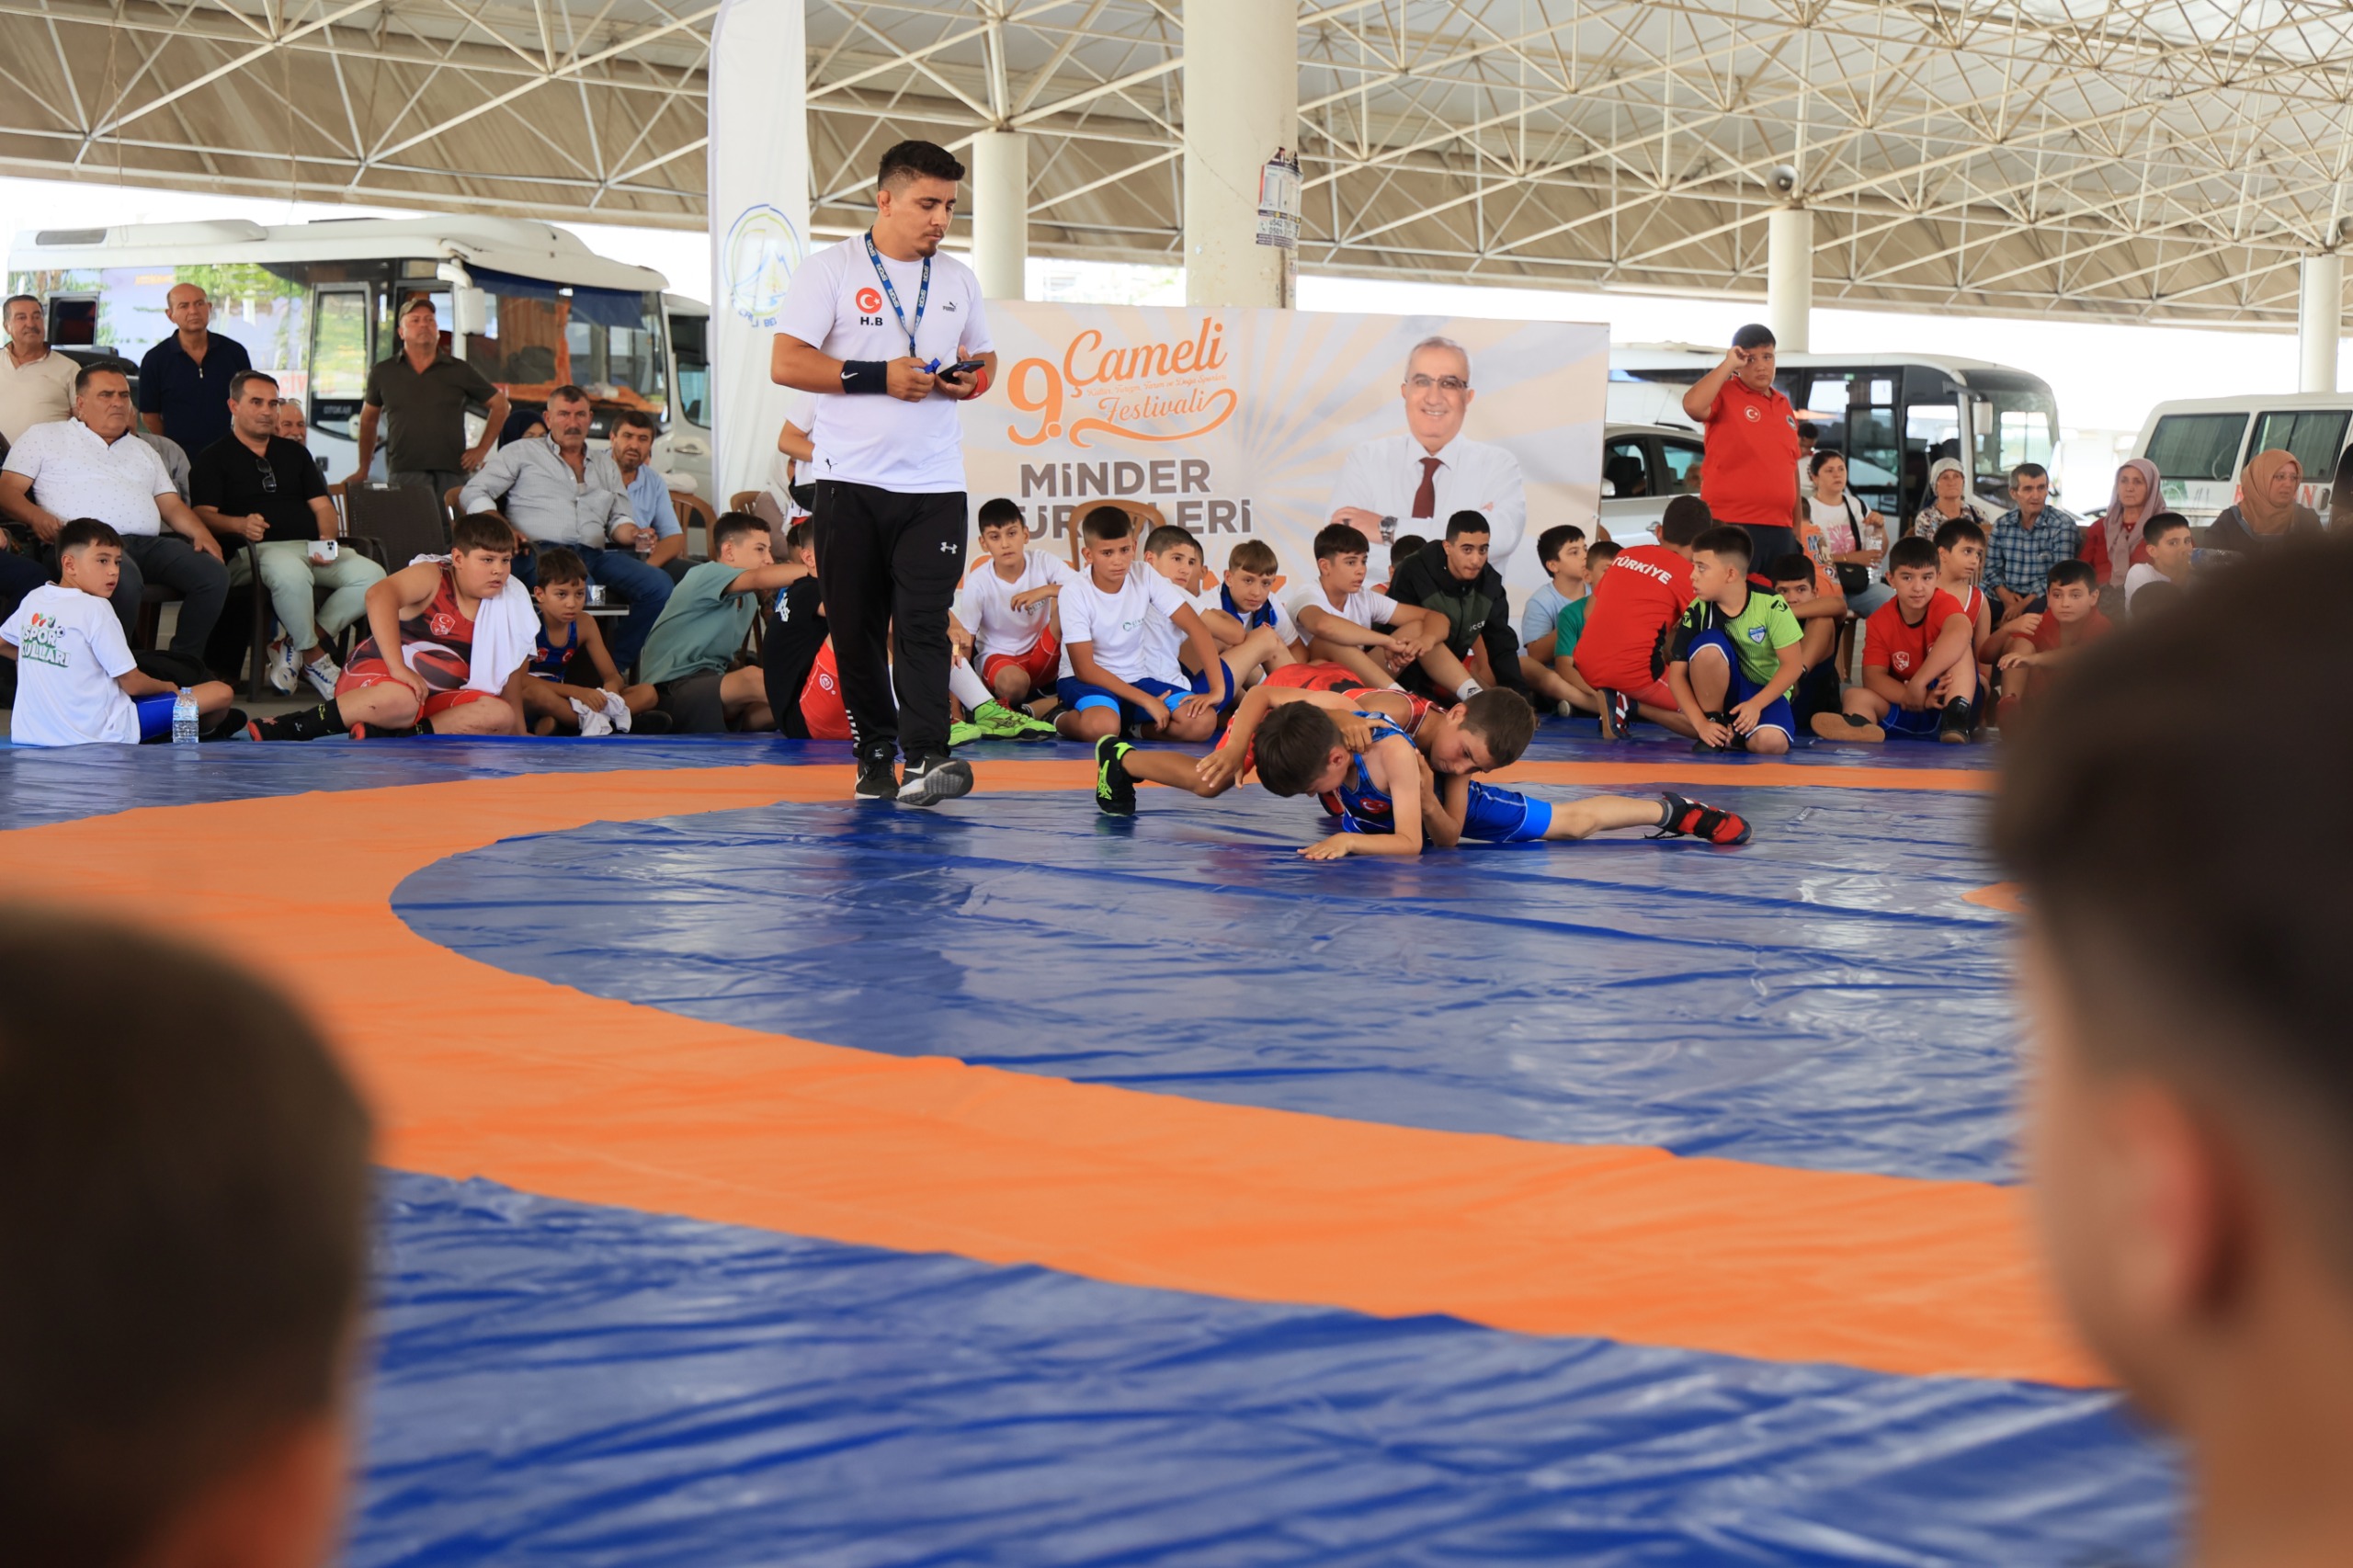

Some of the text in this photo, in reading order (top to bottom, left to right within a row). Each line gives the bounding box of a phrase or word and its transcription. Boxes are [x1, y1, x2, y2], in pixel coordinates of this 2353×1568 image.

[876, 263, 888, 281] SPOR
[888, 288, 900, 308] SPOR
[918, 289, 926, 308] SPOR
[860, 316, 883, 326] H.B
[1007, 317, 1228, 447] 9. Çameli
[1094, 387, 1237, 425] Festivali
[1020, 459, 1211, 499] MİNDER
[1611, 555, 1673, 585] TÜRKİYE
